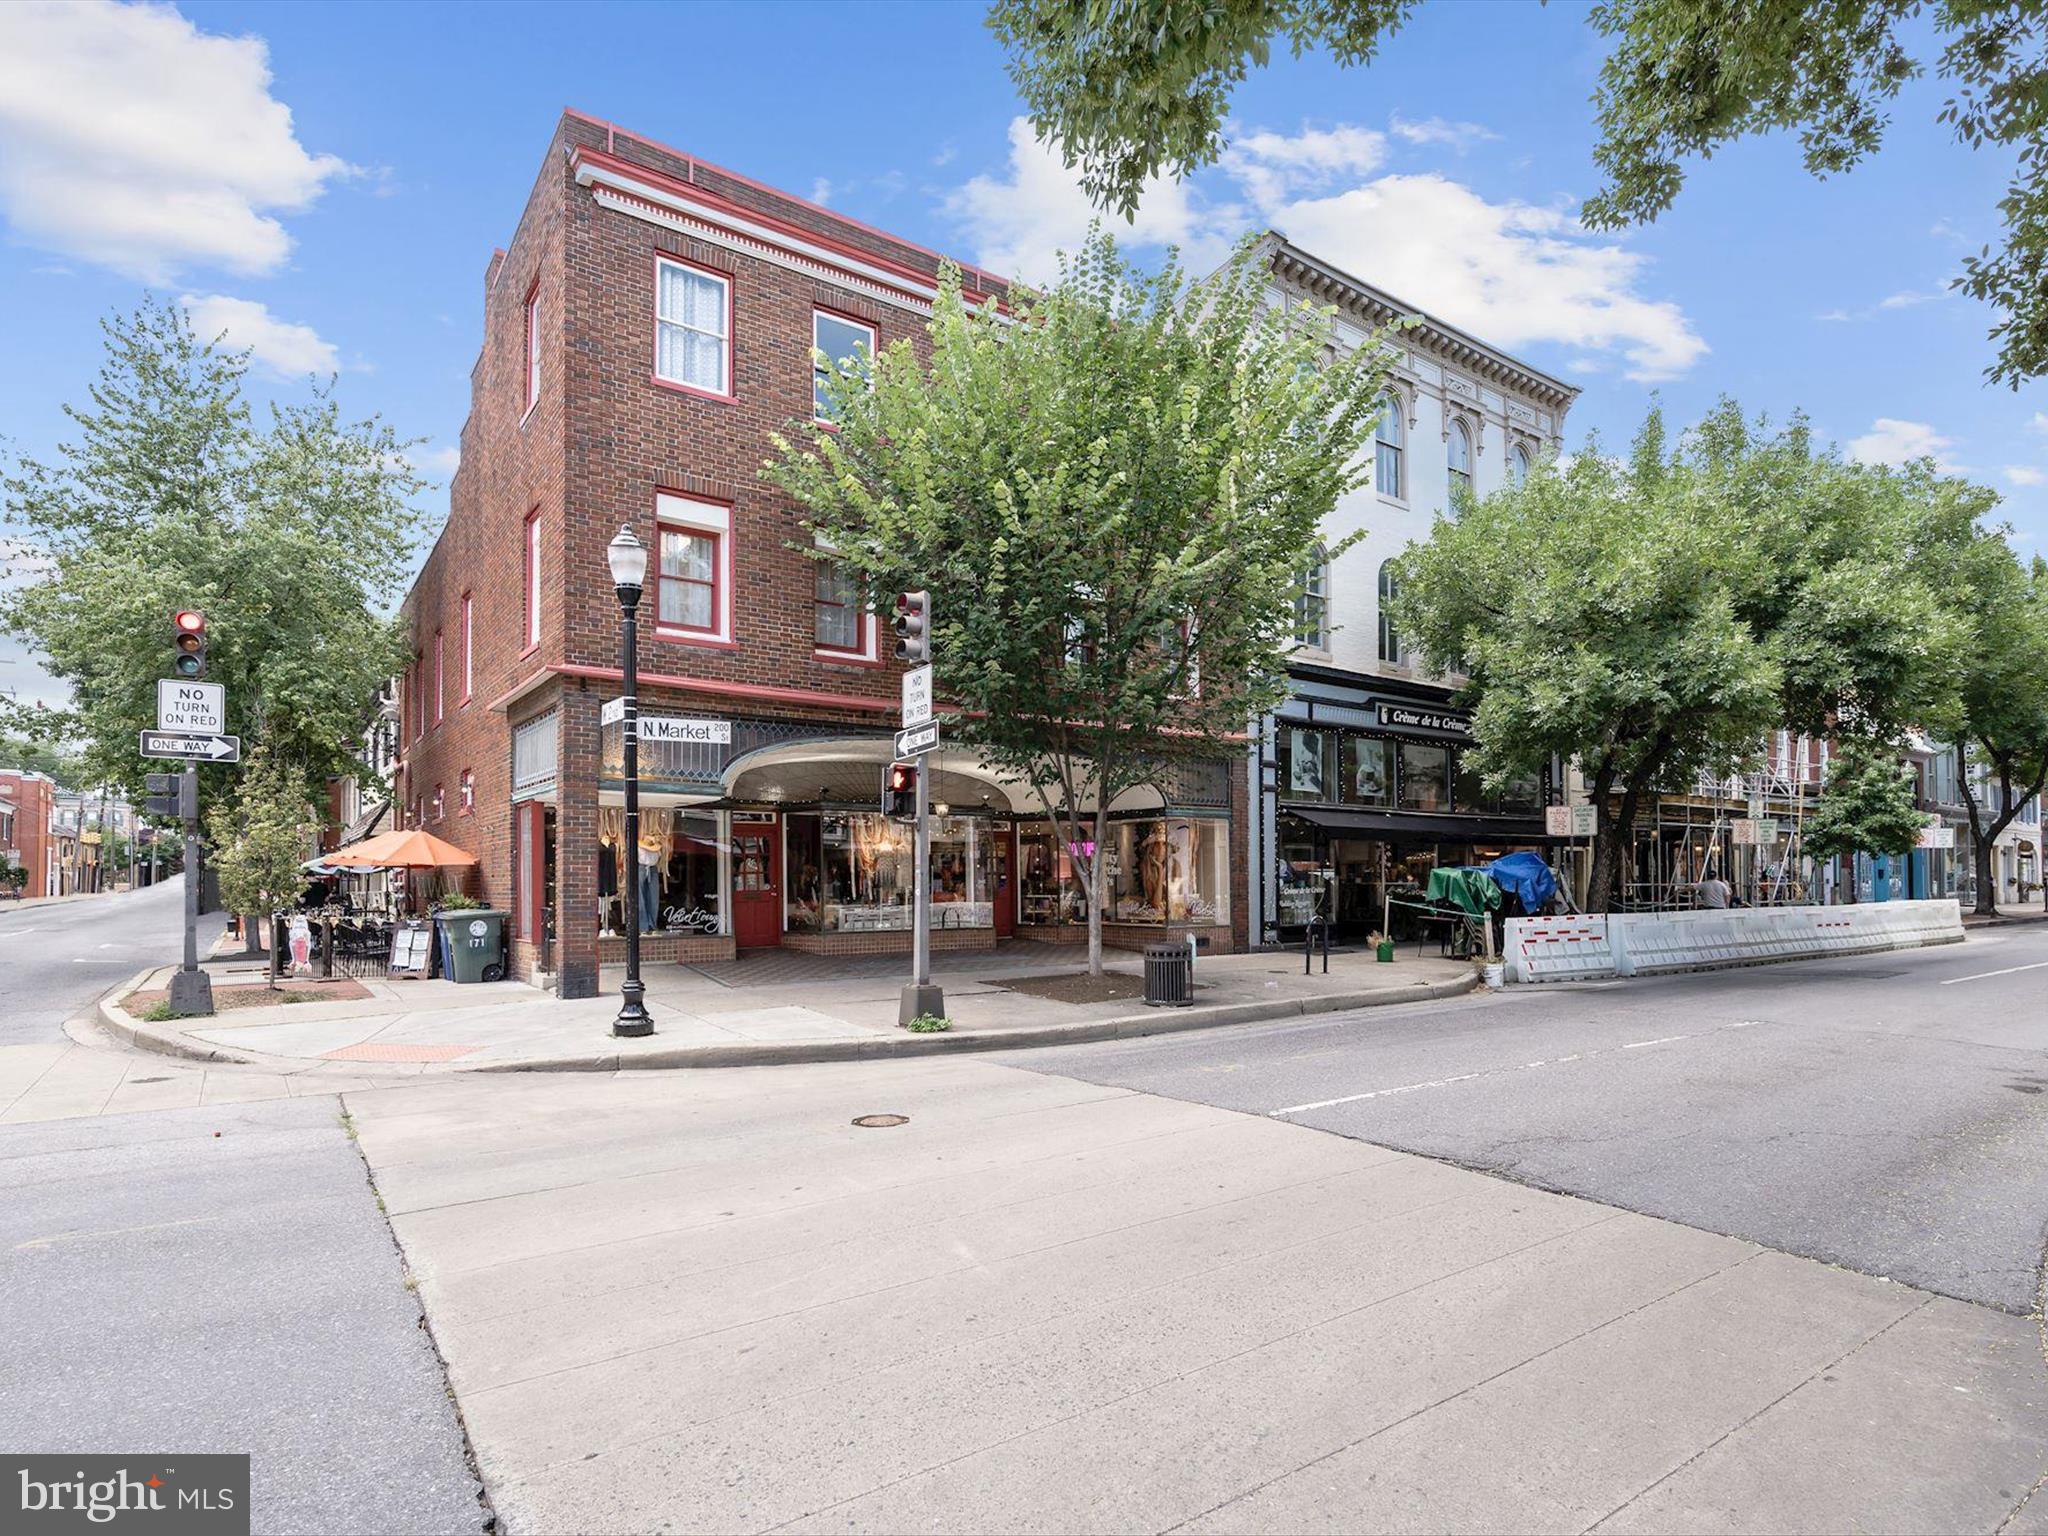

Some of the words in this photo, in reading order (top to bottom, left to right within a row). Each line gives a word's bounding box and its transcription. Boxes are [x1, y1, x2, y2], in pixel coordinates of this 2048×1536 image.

[912, 676, 922, 687] NO
[179, 689, 204, 701] NO
[910, 689, 925, 703] TURN
[174, 702, 209, 713] TURN
[906, 708, 914, 719] ON
[917, 703, 928, 715] RED
[165, 713, 184, 724] ON
[190, 714, 217, 726] RED
[1393, 710, 1419, 725] Crème
[1421, 715, 1431, 727] de
[1432, 716, 1440, 728] la
[658, 722, 711, 740] Market
[714, 723, 729, 732] 200
[907, 735, 918, 747] ONE
[920, 730, 932, 743] WAY
[152, 740, 179, 750] ONE
[183, 741, 210, 752] WAY
[469, 938, 485, 948] 171
